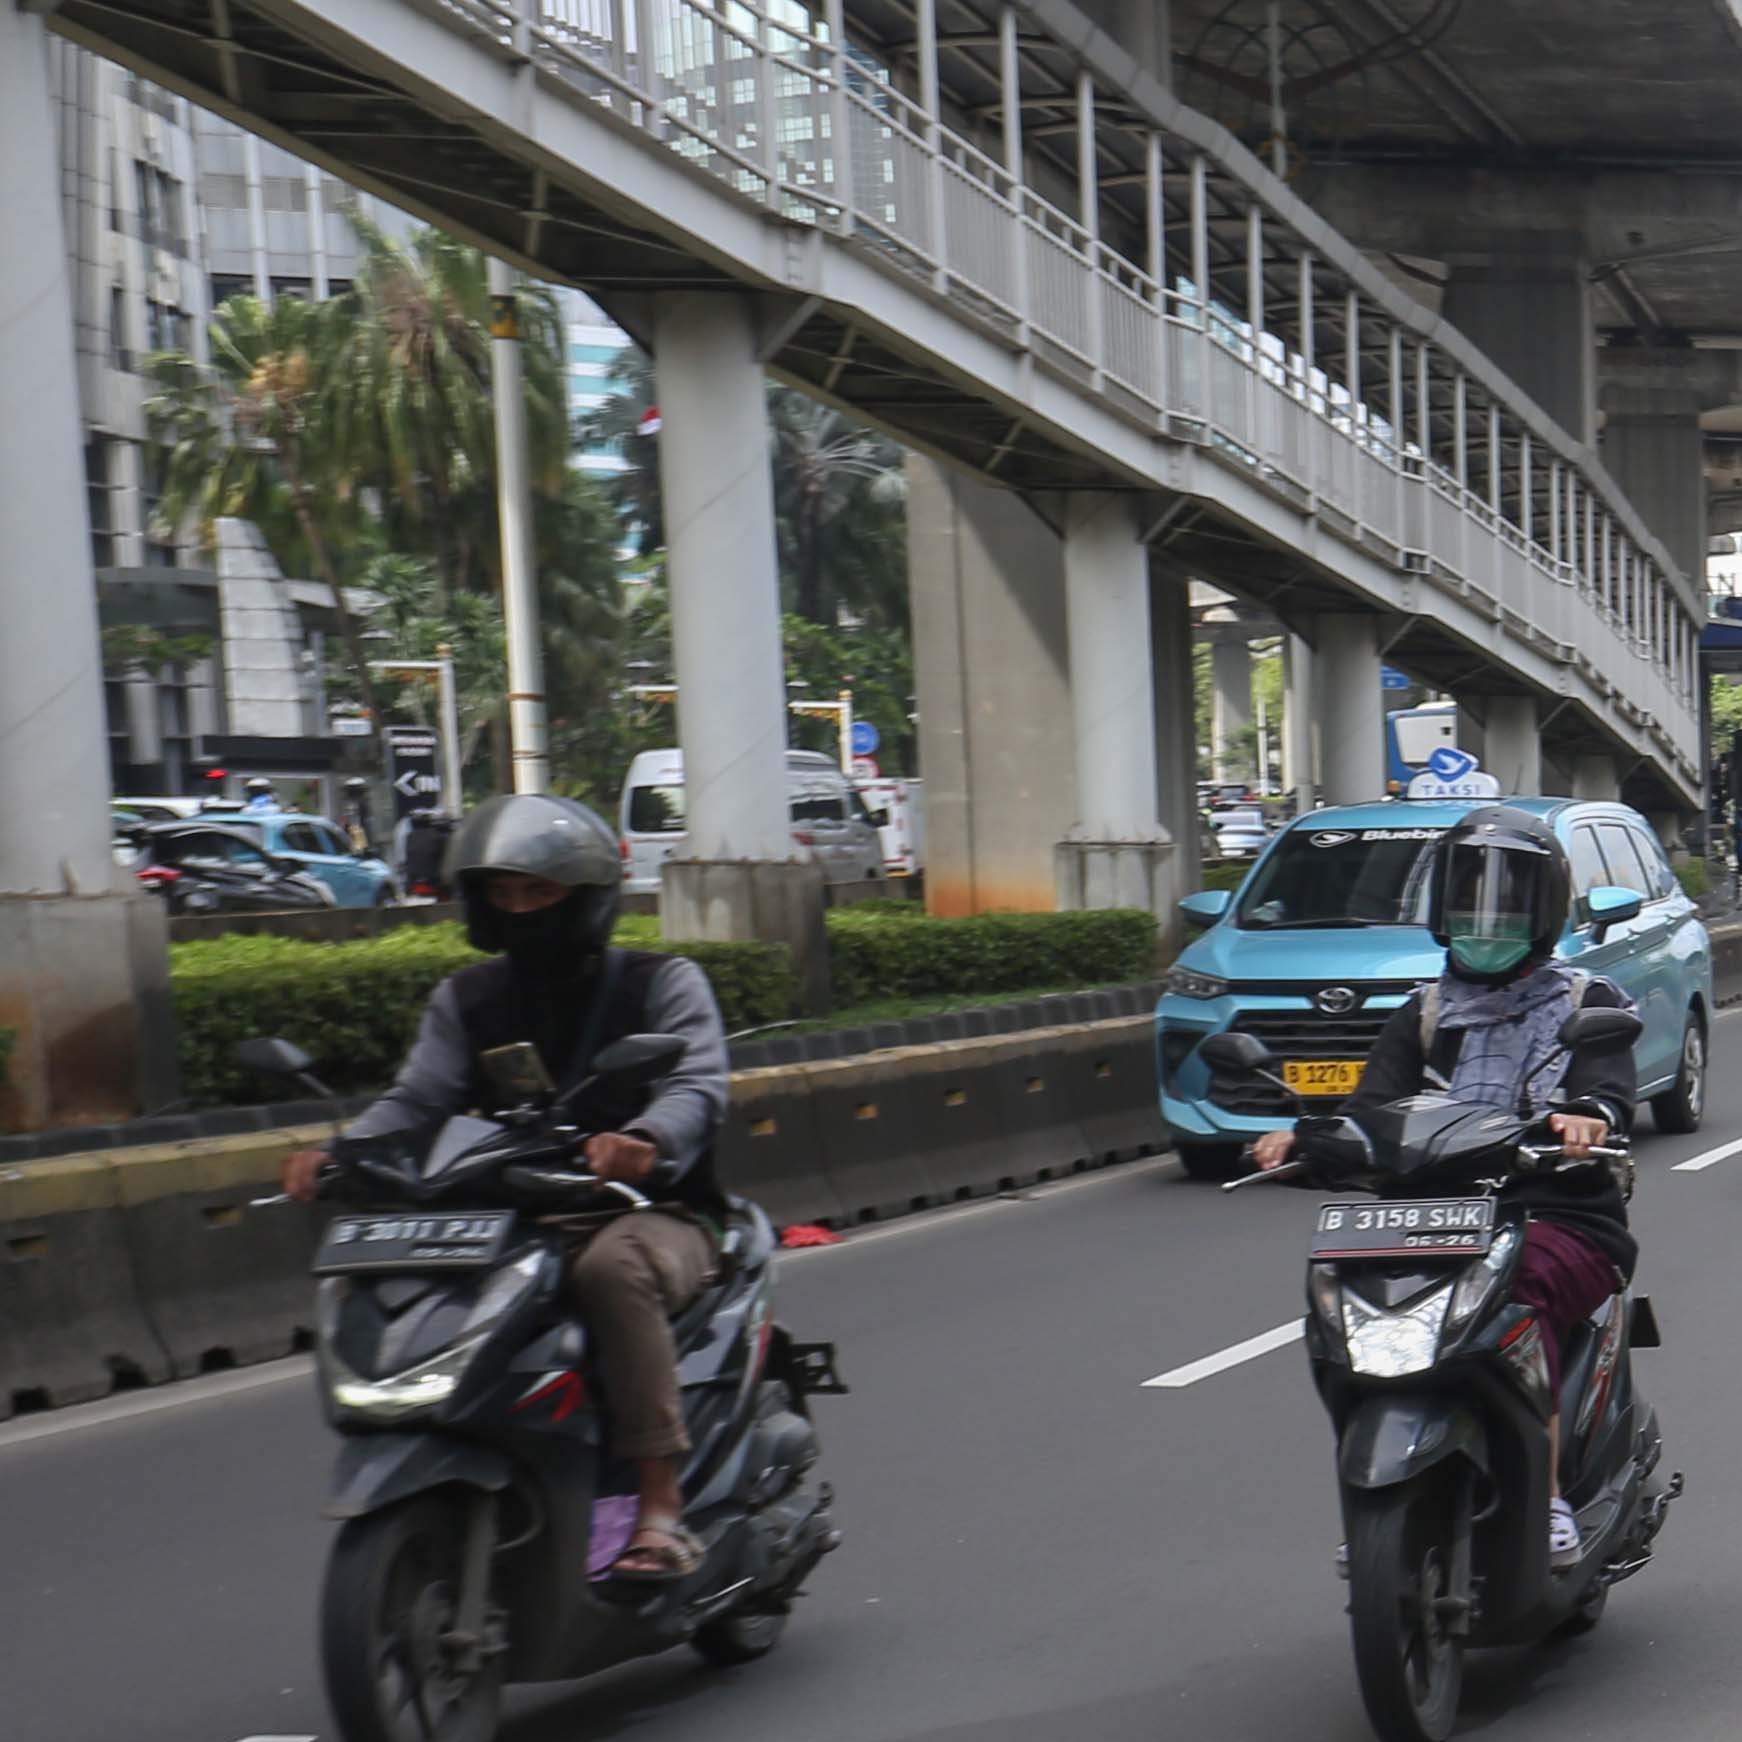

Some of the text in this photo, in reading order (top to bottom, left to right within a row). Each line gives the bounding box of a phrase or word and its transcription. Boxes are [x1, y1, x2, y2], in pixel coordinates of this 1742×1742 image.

[1421, 784, 1481, 796] TAKSI
[1287, 1065, 1299, 1083] B
[1306, 1064, 1348, 1083] 1276
[1325, 1206, 1482, 1231] B 3158 SWK
